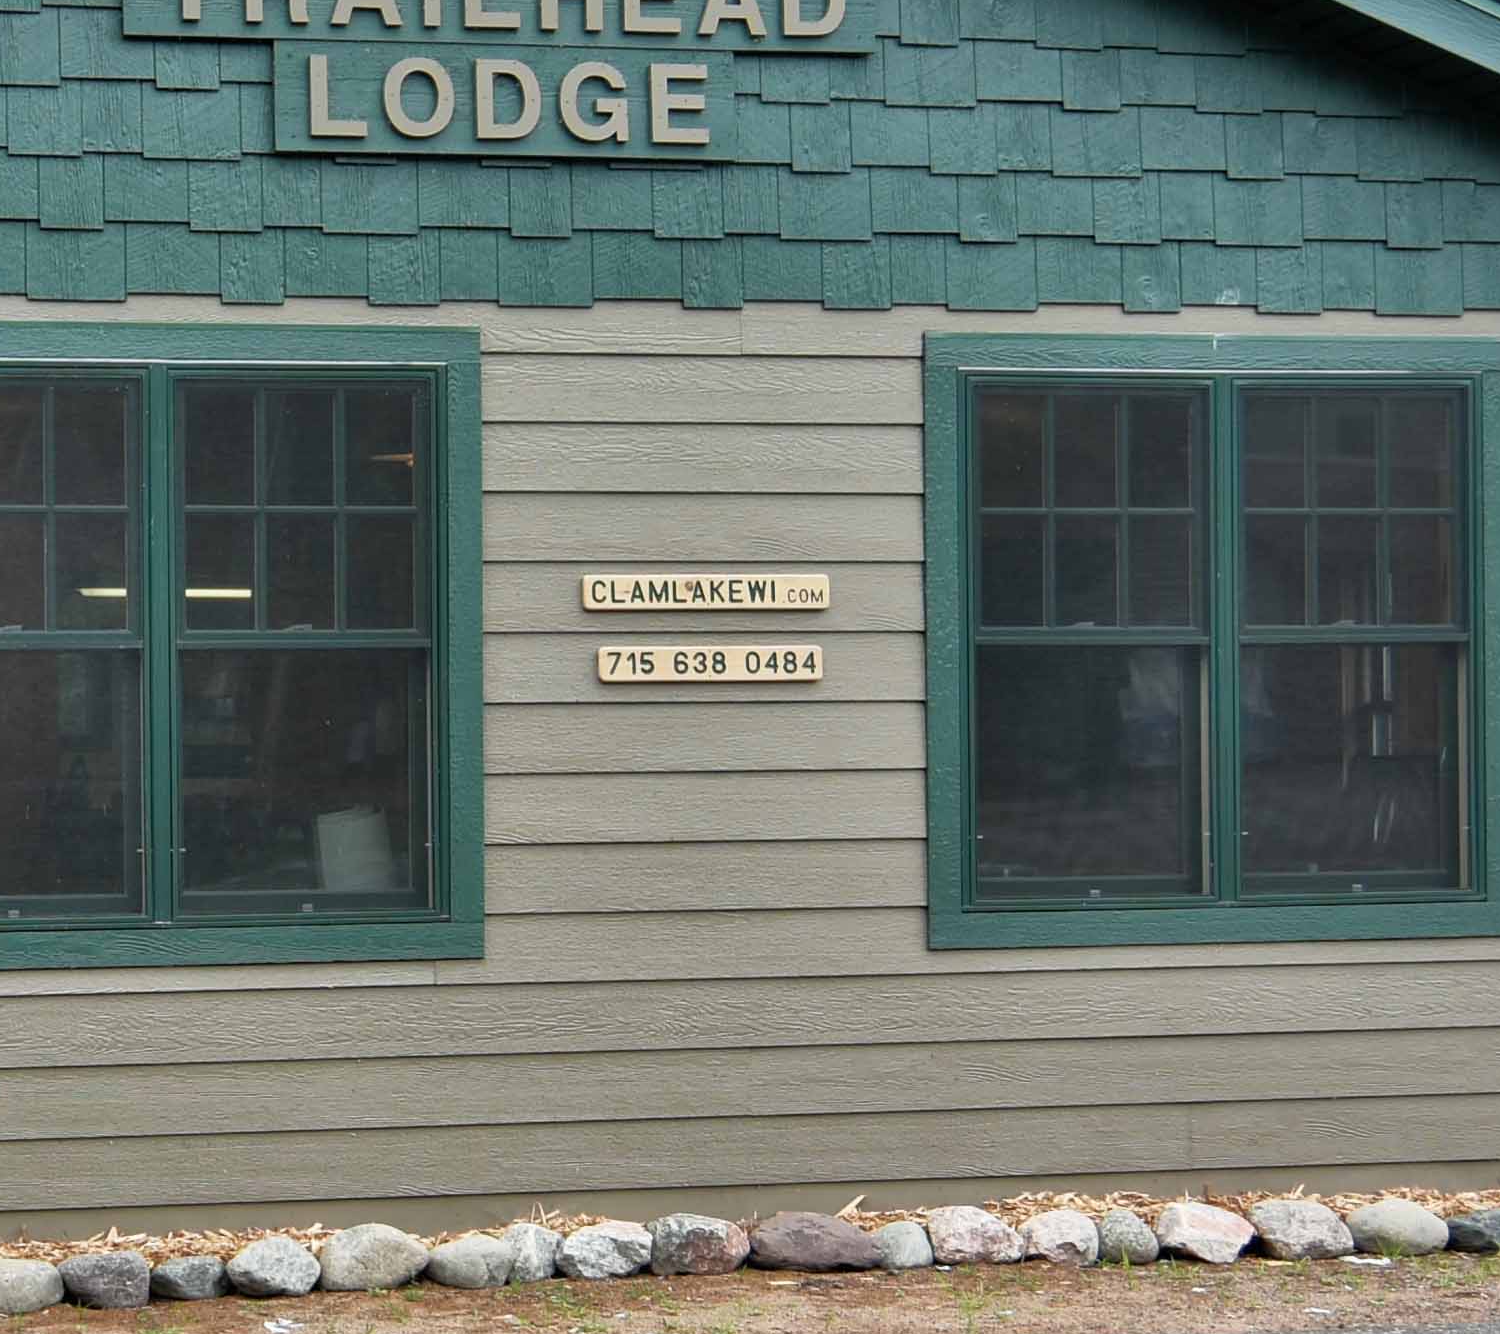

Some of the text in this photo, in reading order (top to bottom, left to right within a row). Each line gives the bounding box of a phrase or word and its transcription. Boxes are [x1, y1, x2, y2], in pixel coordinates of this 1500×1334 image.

[308, 53, 711, 145] LODGE
[606, 650, 817, 676] 715 638 0484
